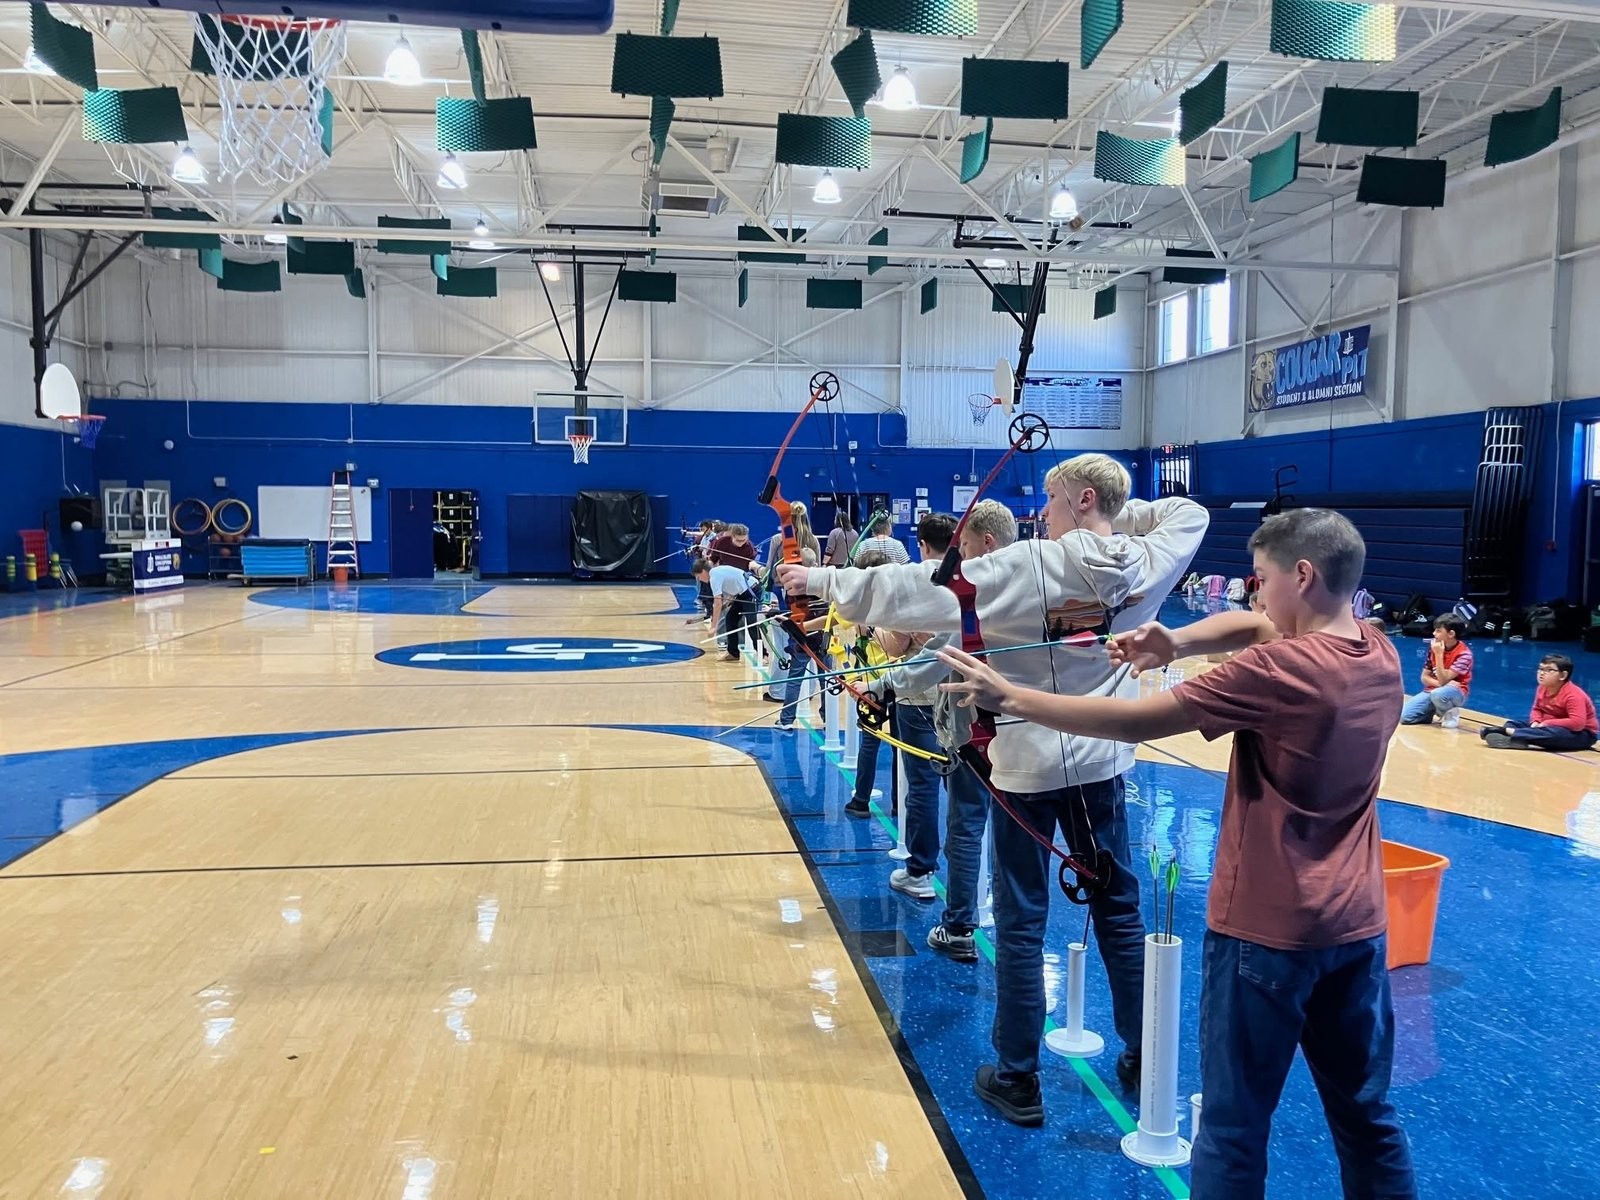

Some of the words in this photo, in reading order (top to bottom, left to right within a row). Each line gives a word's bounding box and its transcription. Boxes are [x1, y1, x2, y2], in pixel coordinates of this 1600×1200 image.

[1276, 331, 1341, 394] COUGAR
[1341, 348, 1369, 384] PIT
[1276, 393, 1301, 405] STUDENT
[1307, 386, 1333, 401] ALUMNI
[1334, 381, 1362, 397] SECTION
